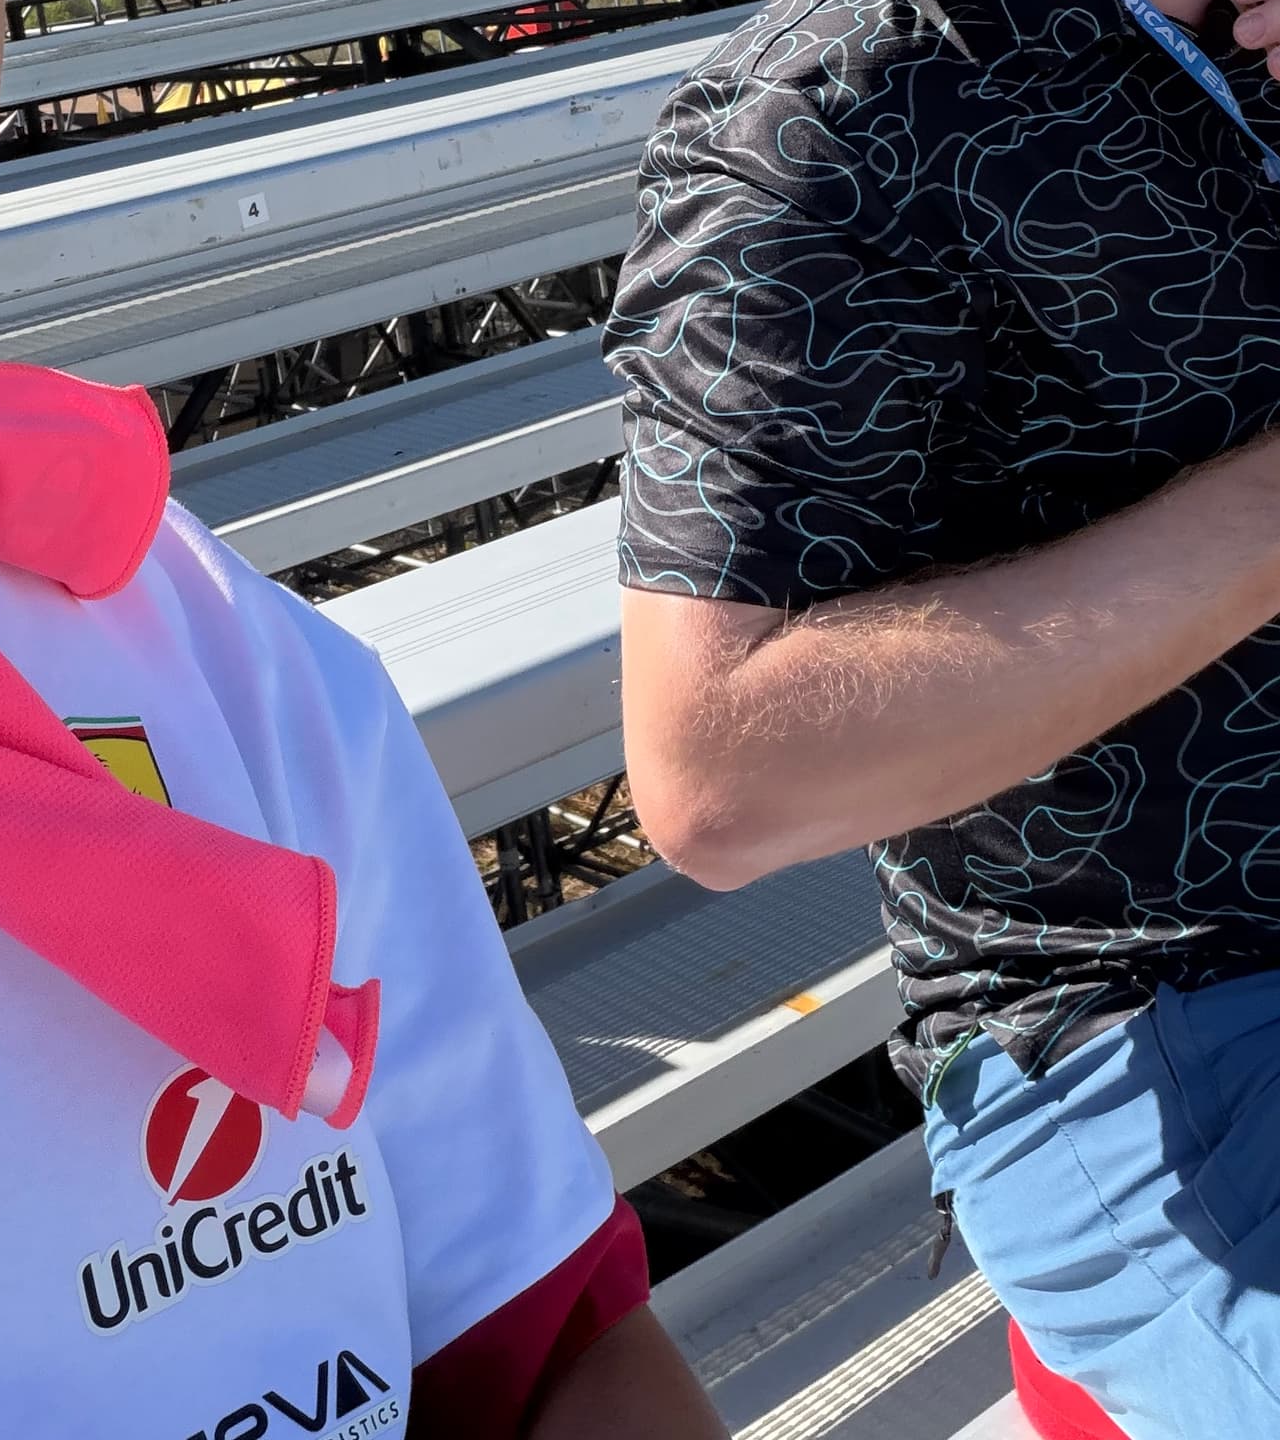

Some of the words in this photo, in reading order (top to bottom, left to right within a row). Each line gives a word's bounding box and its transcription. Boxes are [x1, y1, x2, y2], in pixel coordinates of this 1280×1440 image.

[248, 201, 260, 218] 4
[81, 1151, 367, 1329] UniCredit
[187, 1350, 391, 1440] EVA
